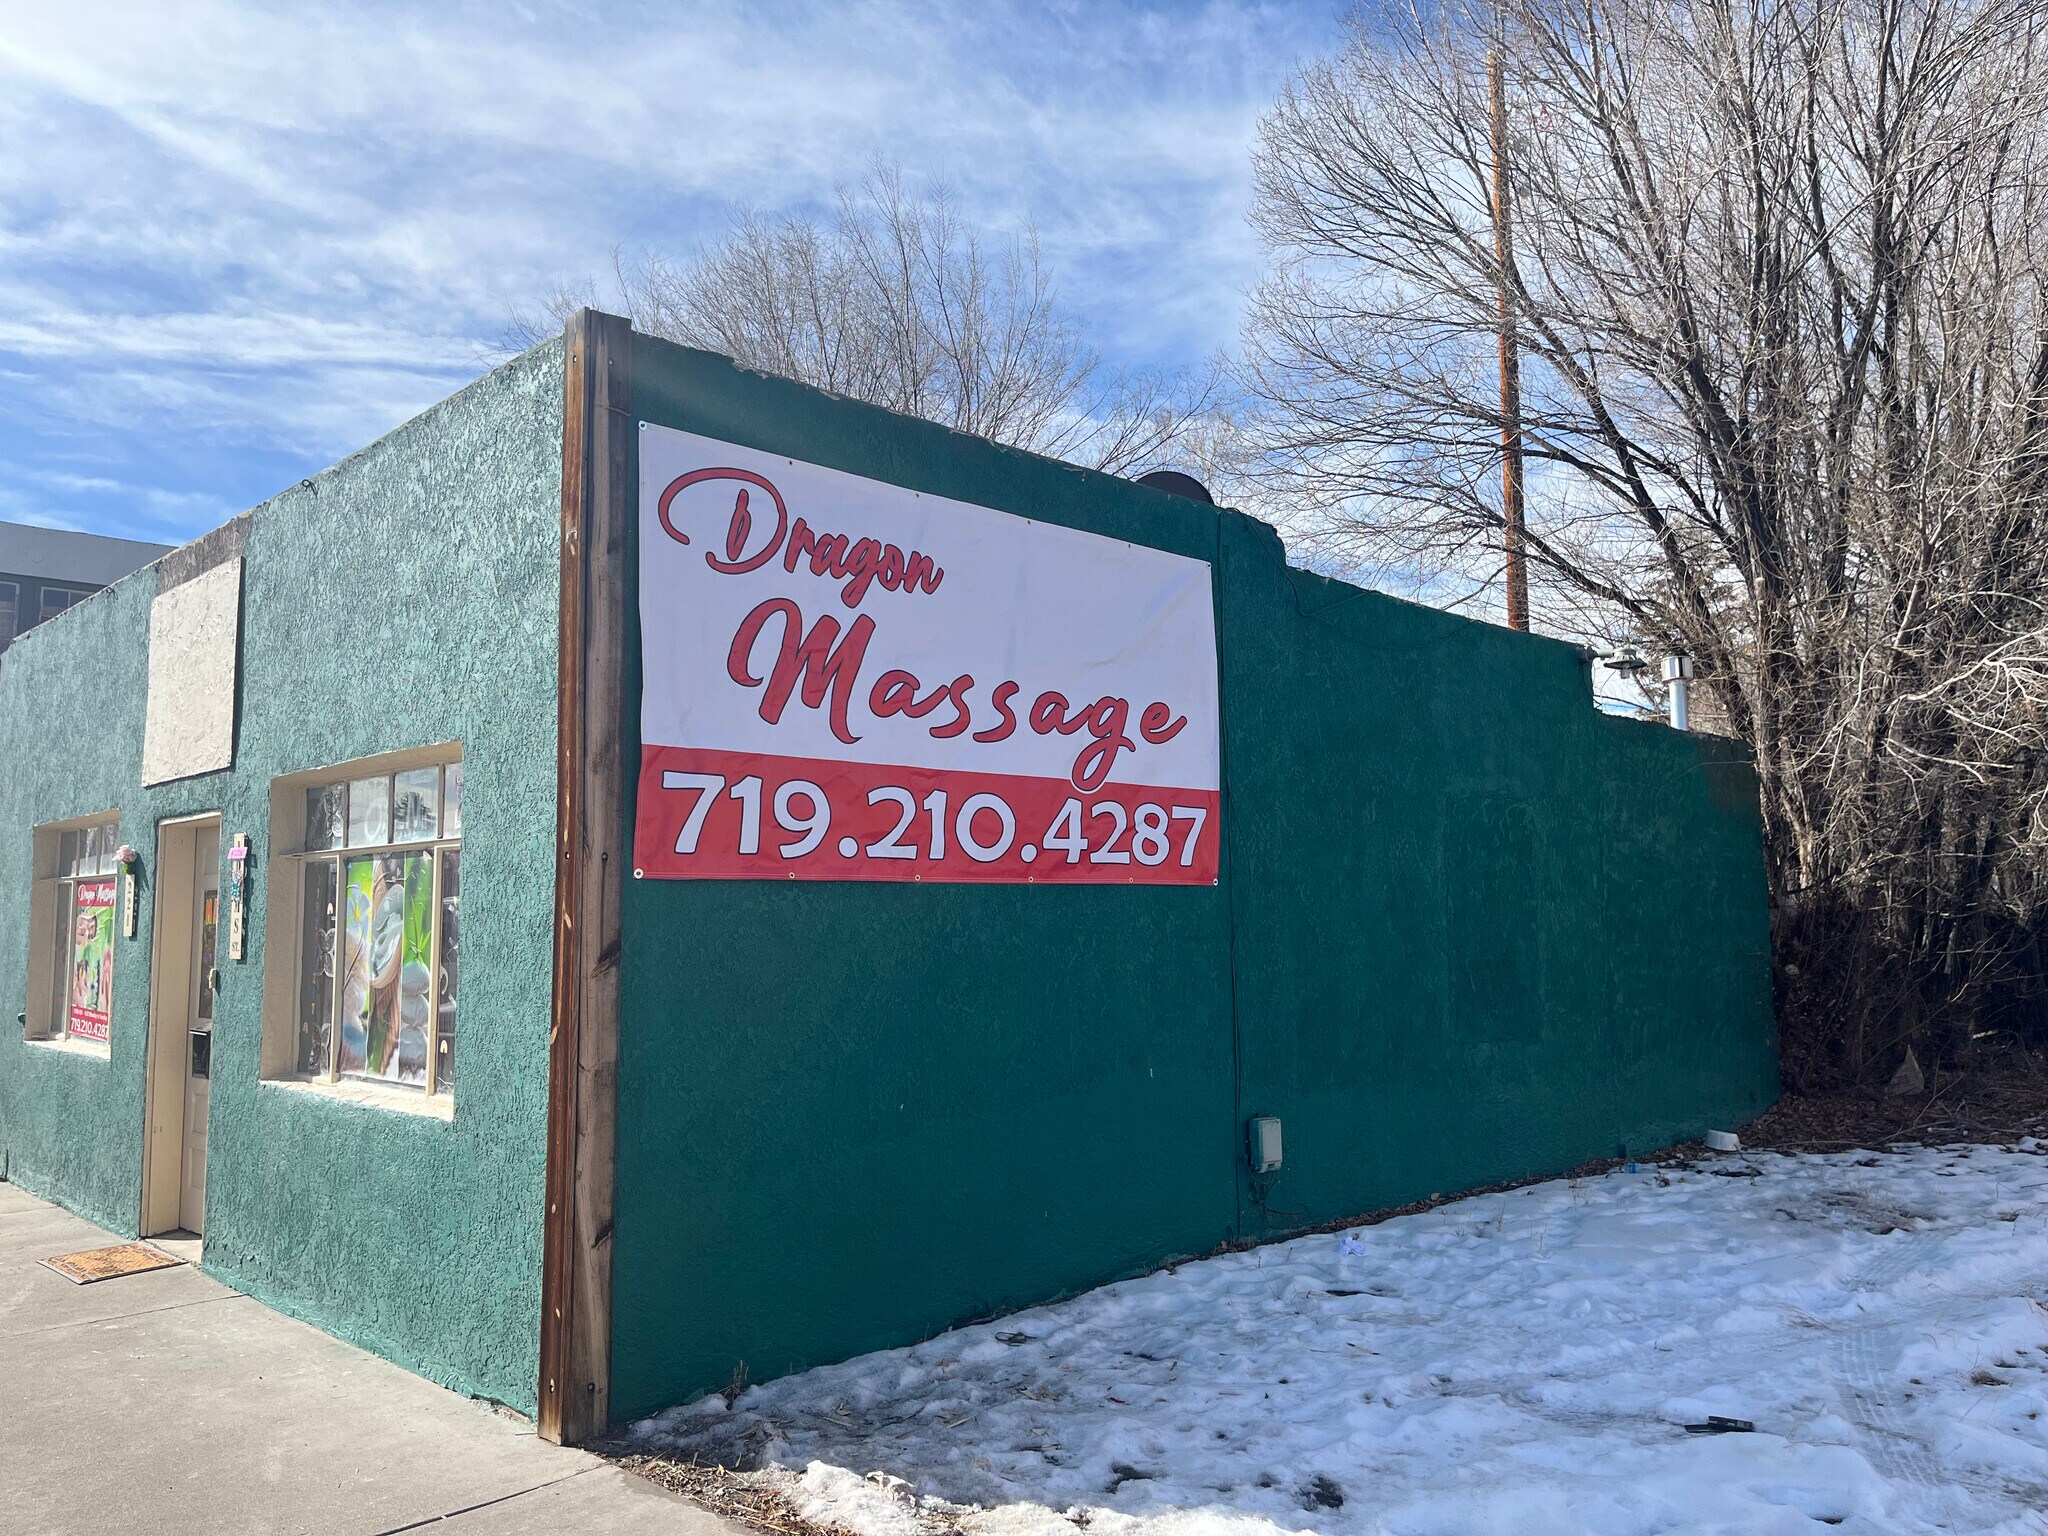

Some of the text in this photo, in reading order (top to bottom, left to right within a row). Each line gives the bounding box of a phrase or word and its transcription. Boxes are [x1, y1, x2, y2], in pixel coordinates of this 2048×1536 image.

[657, 466, 944, 609] Dragon
[726, 597, 1188, 793] Massage
[661, 769, 1208, 868] 719.210.4287
